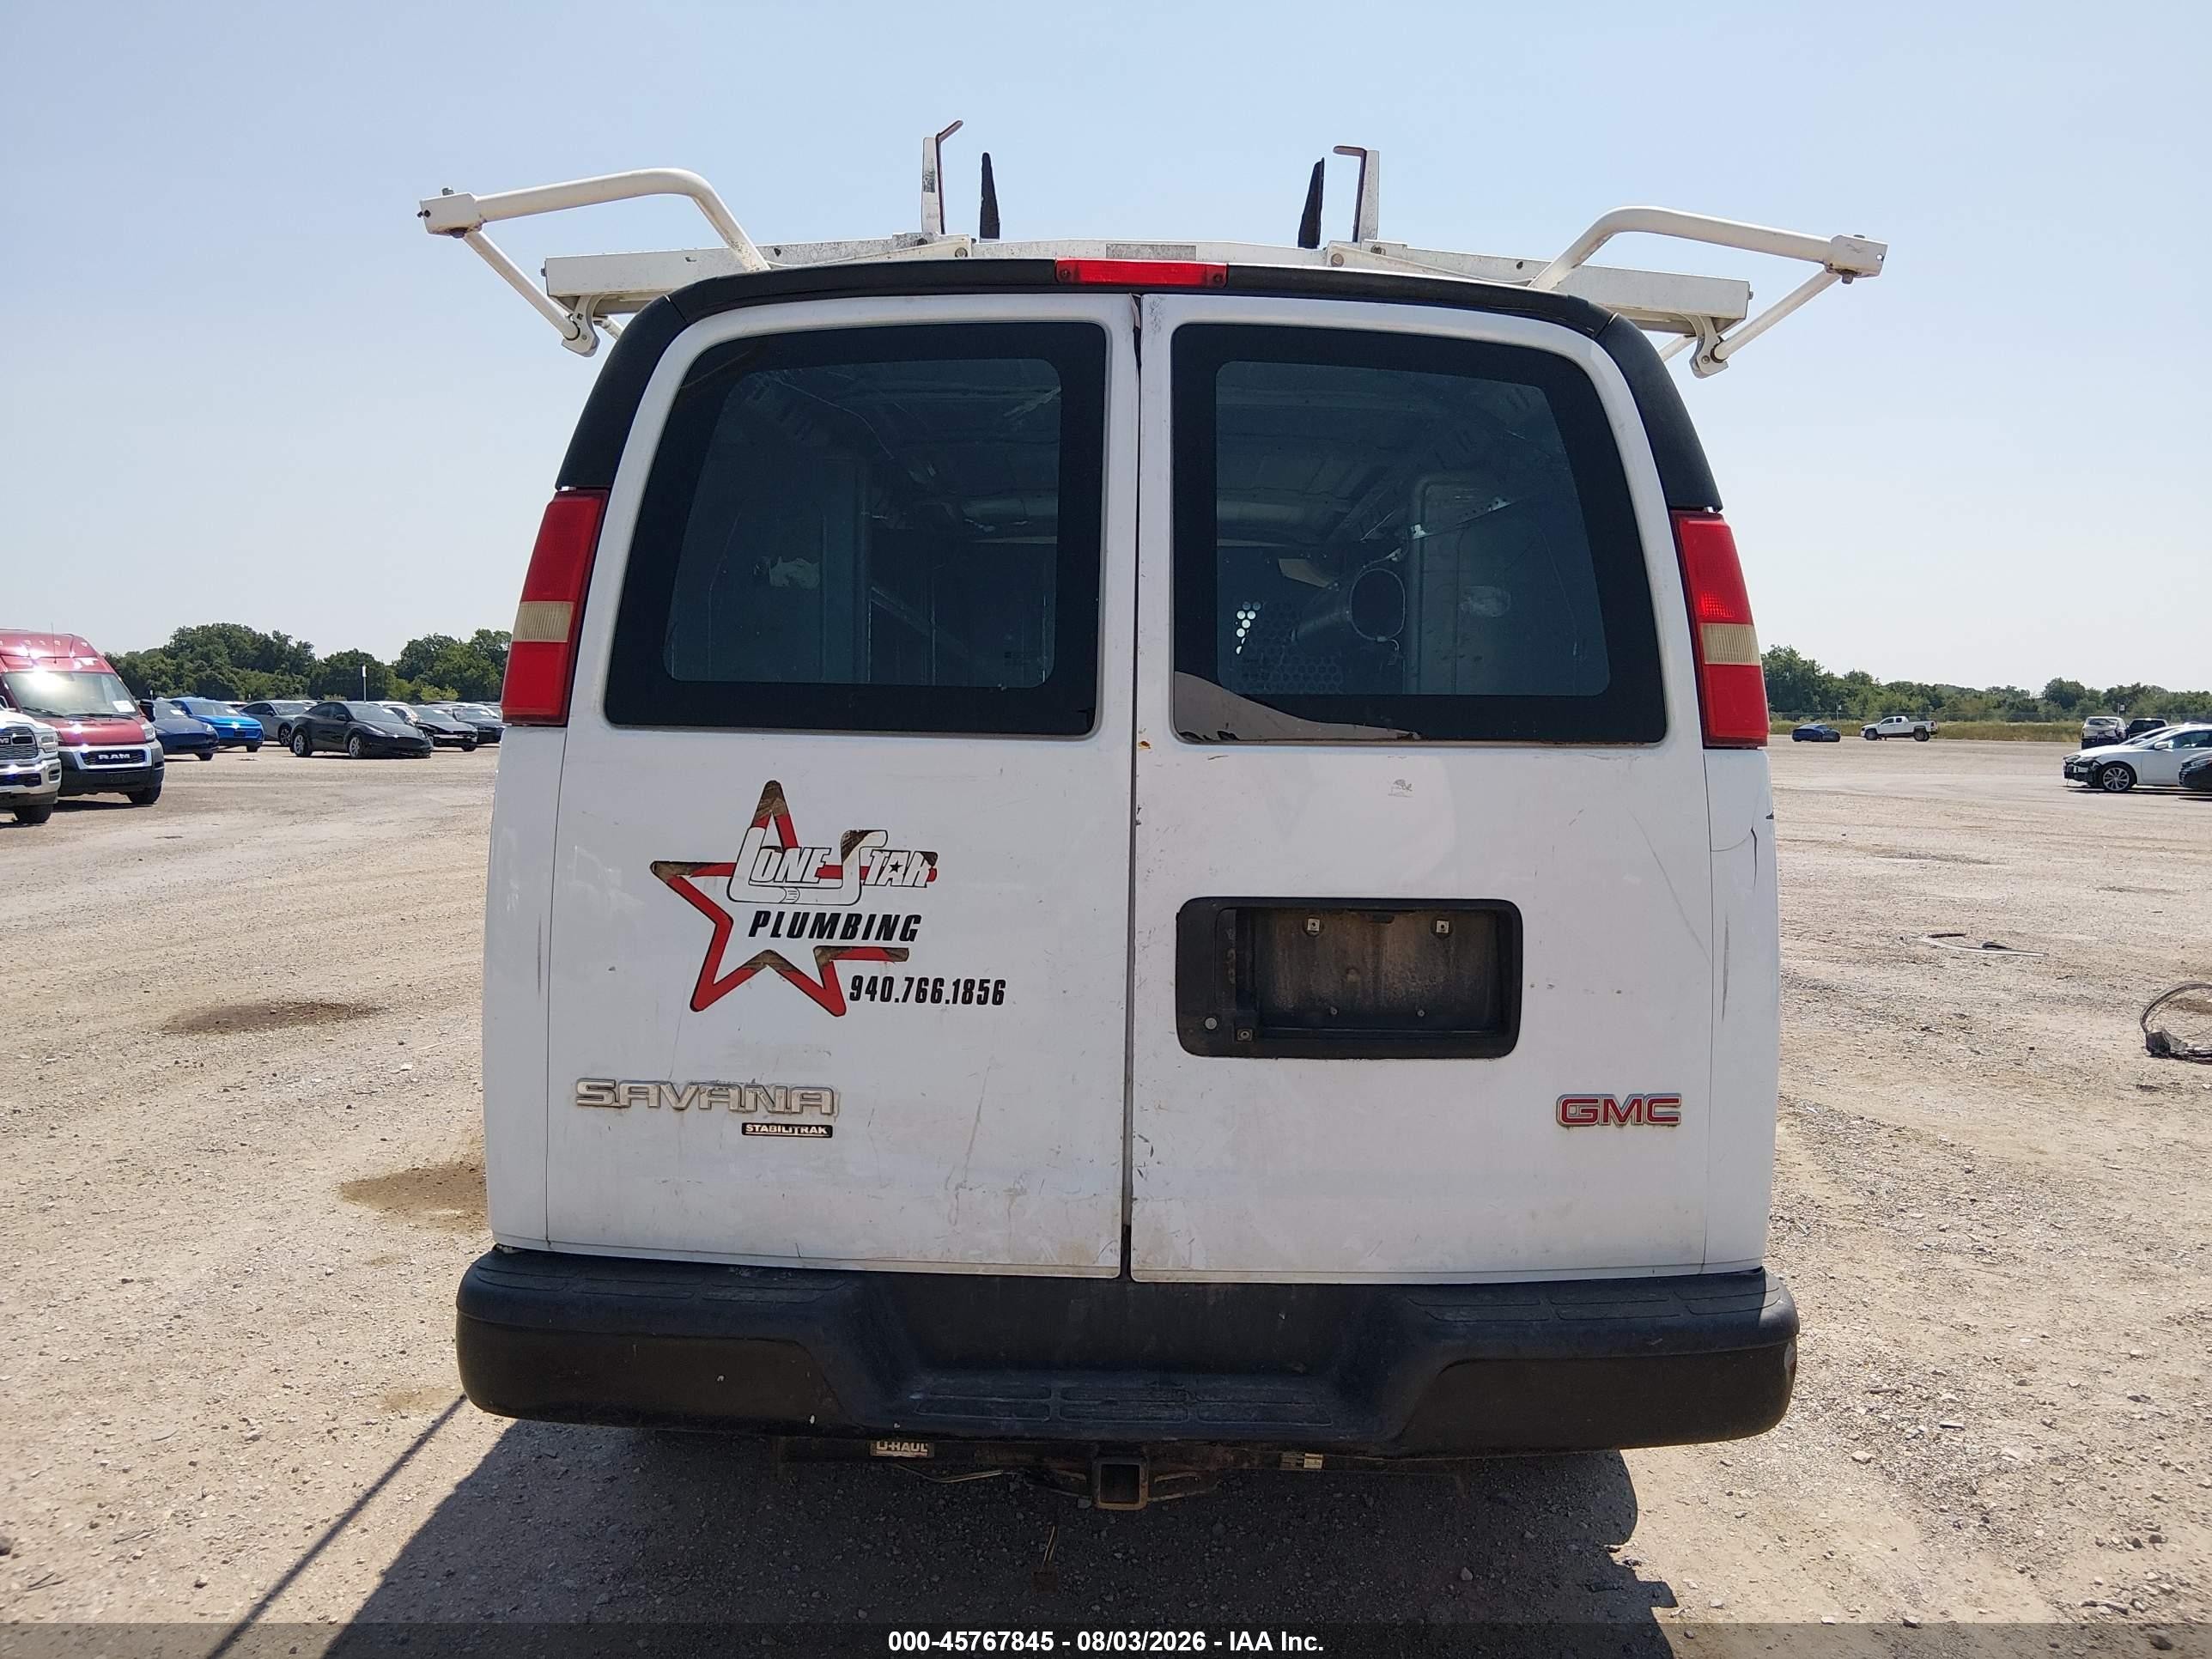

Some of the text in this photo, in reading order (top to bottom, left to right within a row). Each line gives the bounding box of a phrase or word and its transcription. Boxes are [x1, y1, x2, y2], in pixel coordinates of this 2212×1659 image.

[726, 826, 939, 906] LONE STAR
[748, 910, 922, 942] PLUMBING
[849, 975, 1006, 1006] 940.766.1856
[575, 1079, 835, 1115] SAVANA
[1556, 1093, 1682, 1127] GMC
[745, 1124, 828, 1134] STABILITRAK
[876, 1441, 928, 1452] U-HAUL
